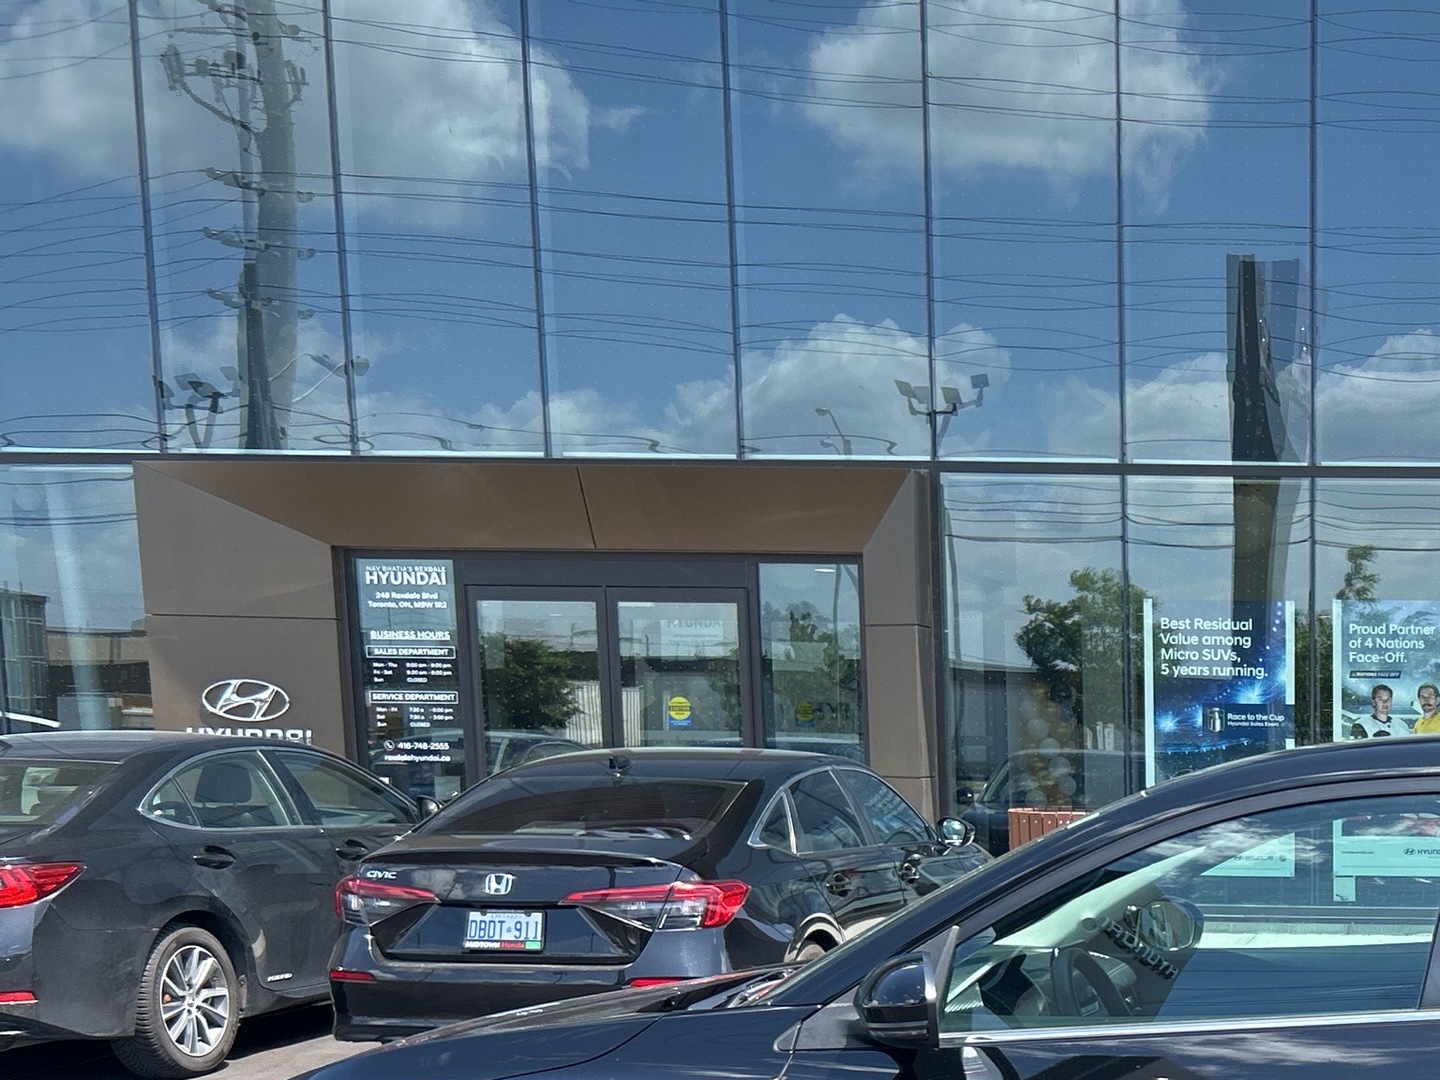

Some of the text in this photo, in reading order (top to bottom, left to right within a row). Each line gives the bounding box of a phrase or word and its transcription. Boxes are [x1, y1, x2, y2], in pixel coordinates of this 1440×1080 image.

[365, 571, 446, 585] HYUNDAI
[1160, 617, 1253, 631] Best Residual
[1349, 623, 1436, 635] Proud Partner
[370, 630, 450, 639] BUSINESS HOURS
[1160, 633, 1251, 649] Value among
[1349, 637, 1425, 649] of 4 Nations
[1160, 648, 1241, 663] Micro SUVs,
[1349, 651, 1408, 663] Face-Off.
[1160, 663, 1269, 679] 5 years running.
[1269, 714, 1285, 722] Cup
[366, 870, 397, 879] CIVIC
[469, 920, 539, 940] DBDT 911
